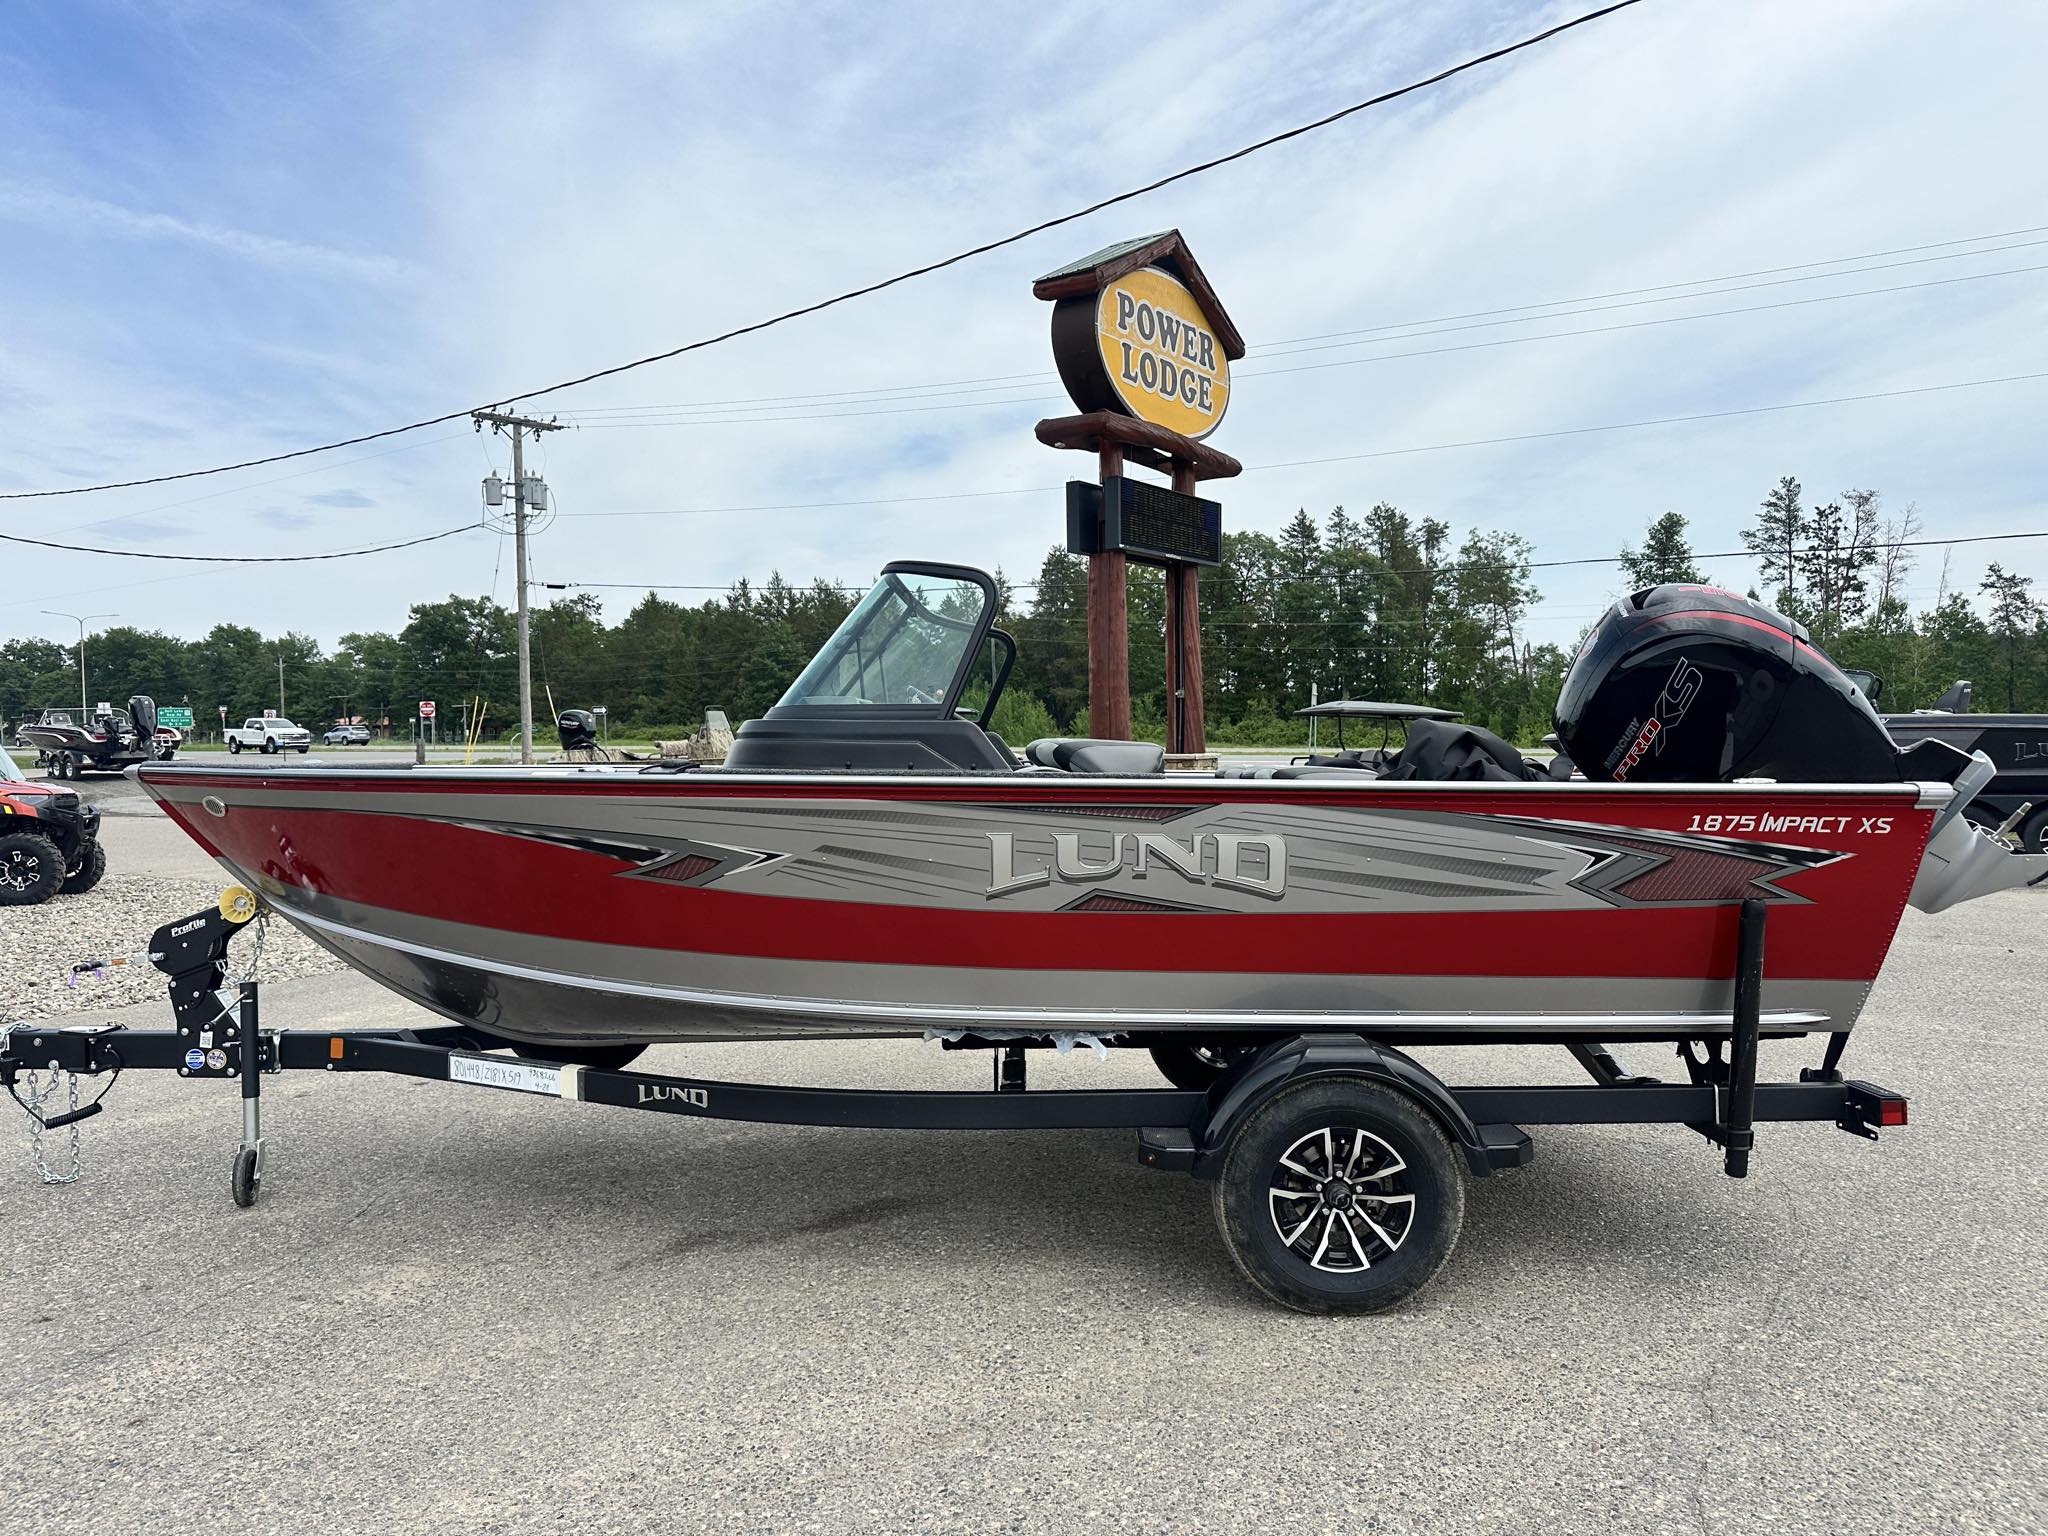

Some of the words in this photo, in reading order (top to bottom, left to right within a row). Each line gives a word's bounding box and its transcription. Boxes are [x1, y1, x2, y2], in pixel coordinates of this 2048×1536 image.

[1117, 290, 1216, 371] POWER
[1121, 342, 1213, 412] LODGE
[1604, 716, 1640, 769] MERCURY
[1612, 717, 1662, 783] PRO
[1686, 815, 1757, 832] 1875
[1758, 812, 1853, 833] IMPACT
[1857, 817, 1895, 834] XS
[985, 832, 1288, 901] LUND
[171, 918, 206, 938] Profile
[637, 1084, 709, 1108] LUND
